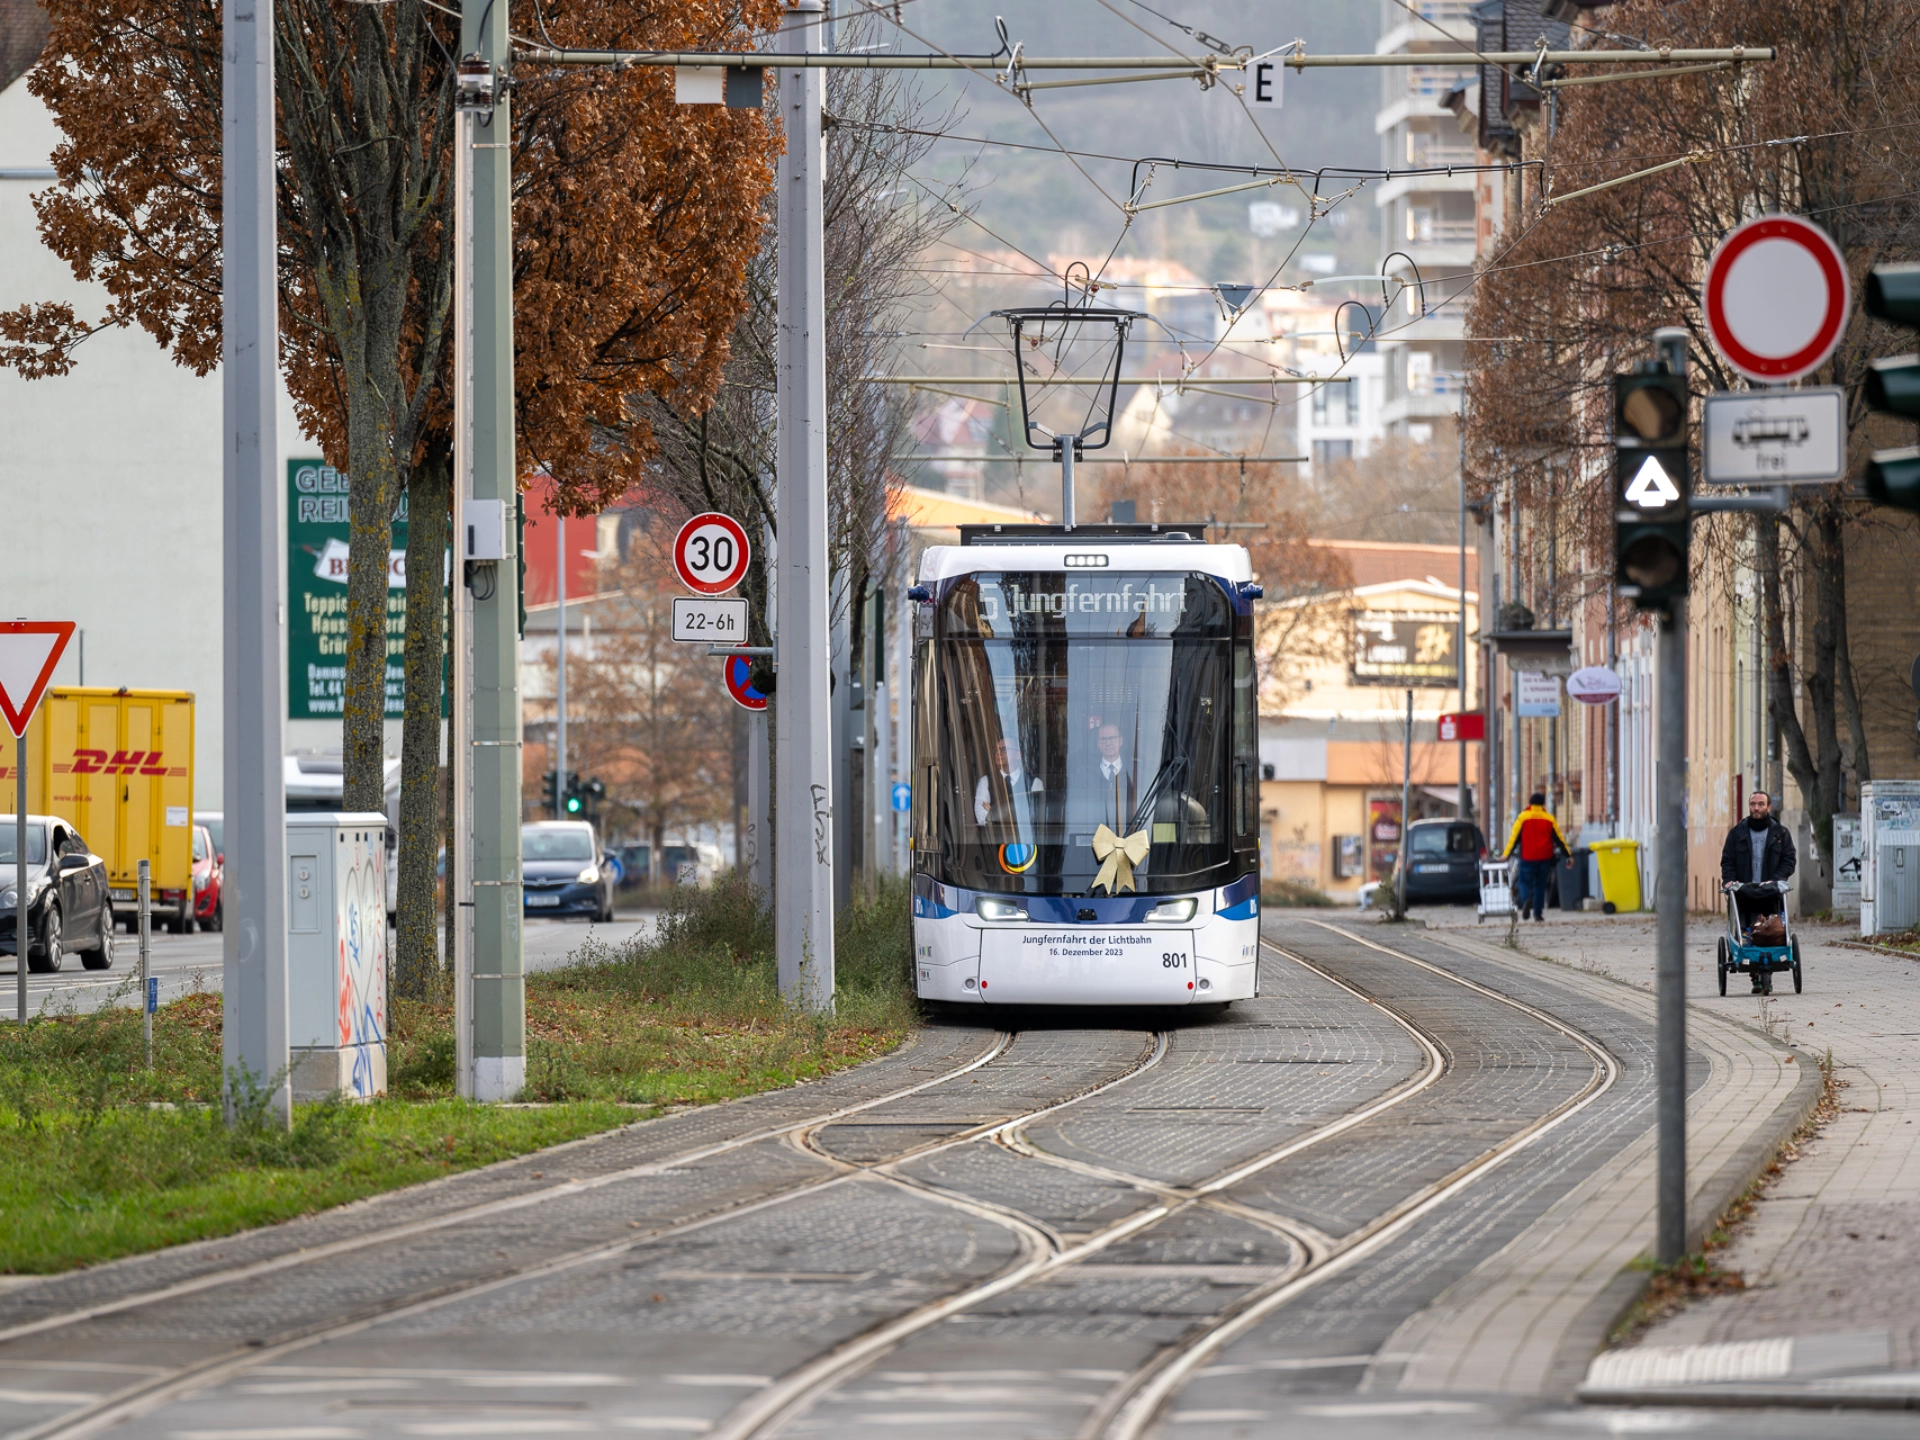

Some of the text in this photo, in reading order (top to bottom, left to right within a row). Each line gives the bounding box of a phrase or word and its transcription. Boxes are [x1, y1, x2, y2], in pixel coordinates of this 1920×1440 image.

[1256, 64, 1273, 102] E
[1756, 453, 1785, 471] frei
[691, 536, 732, 572] 30
[980, 583, 1188, 620] 5 Jungfernfahrt
[686, 612, 734, 631] 22-6h
[71, 749, 168, 776] DHL
[1022, 935, 1152, 946] Jungfernfahrt der Lichtbahn
[1049, 948, 1123, 956] 16. Dezember 2023
[1162, 953, 1187, 968] 801
